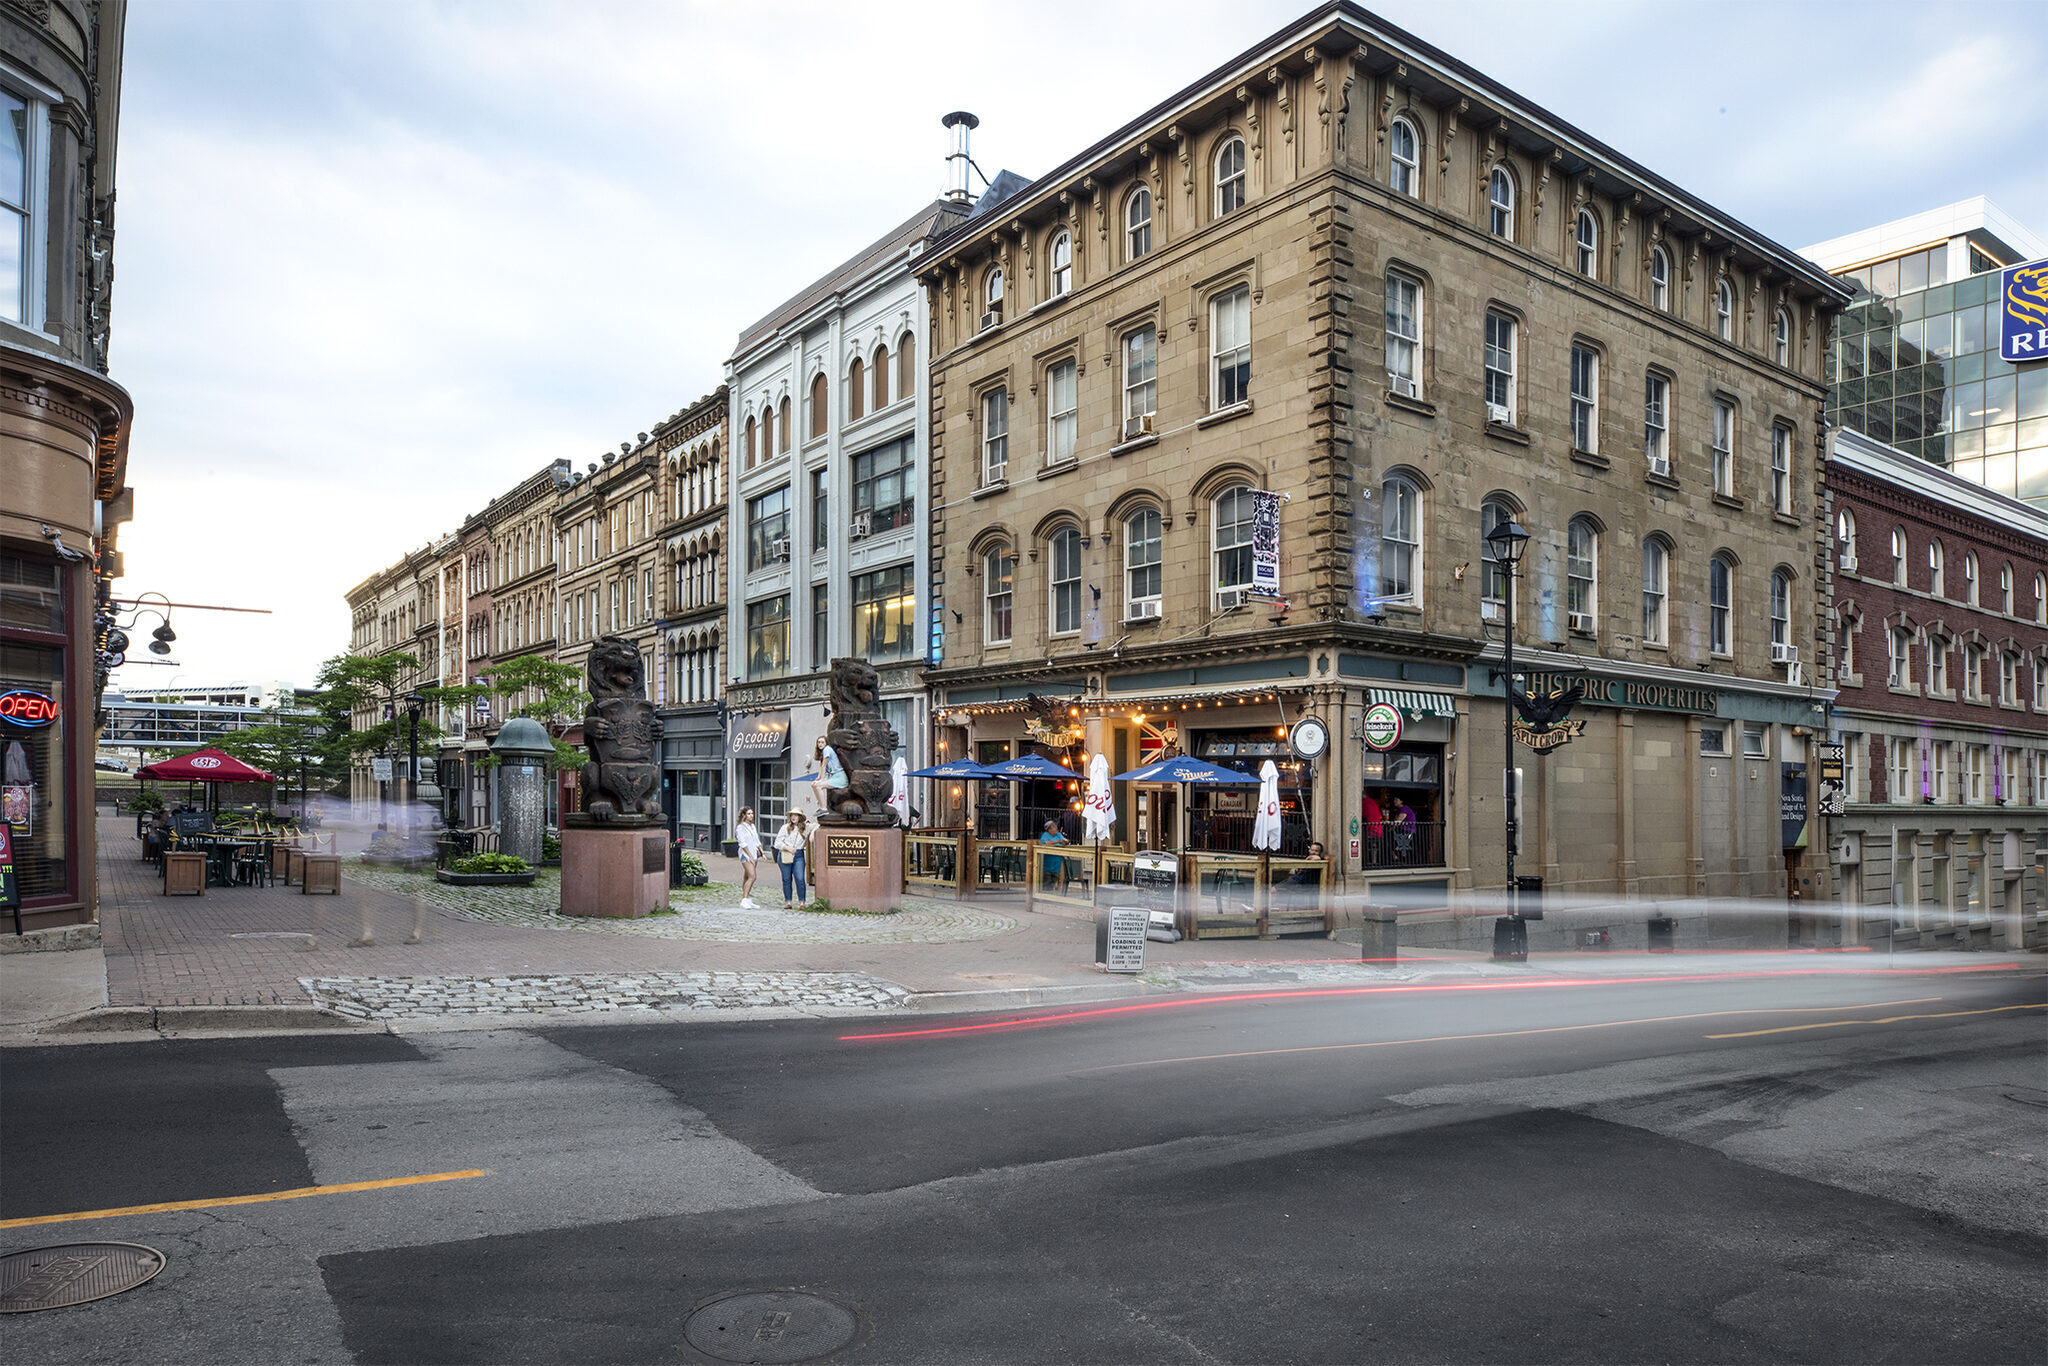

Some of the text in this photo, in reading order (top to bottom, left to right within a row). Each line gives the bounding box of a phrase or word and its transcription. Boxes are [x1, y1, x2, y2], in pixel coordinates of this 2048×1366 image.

[1532, 672, 1716, 711] HISTORIC PROPERTIES
[0, 696, 57, 719] OPEN
[745, 731, 780, 743] COOKED
[1515, 729, 1565, 747] SPLIT CROW
